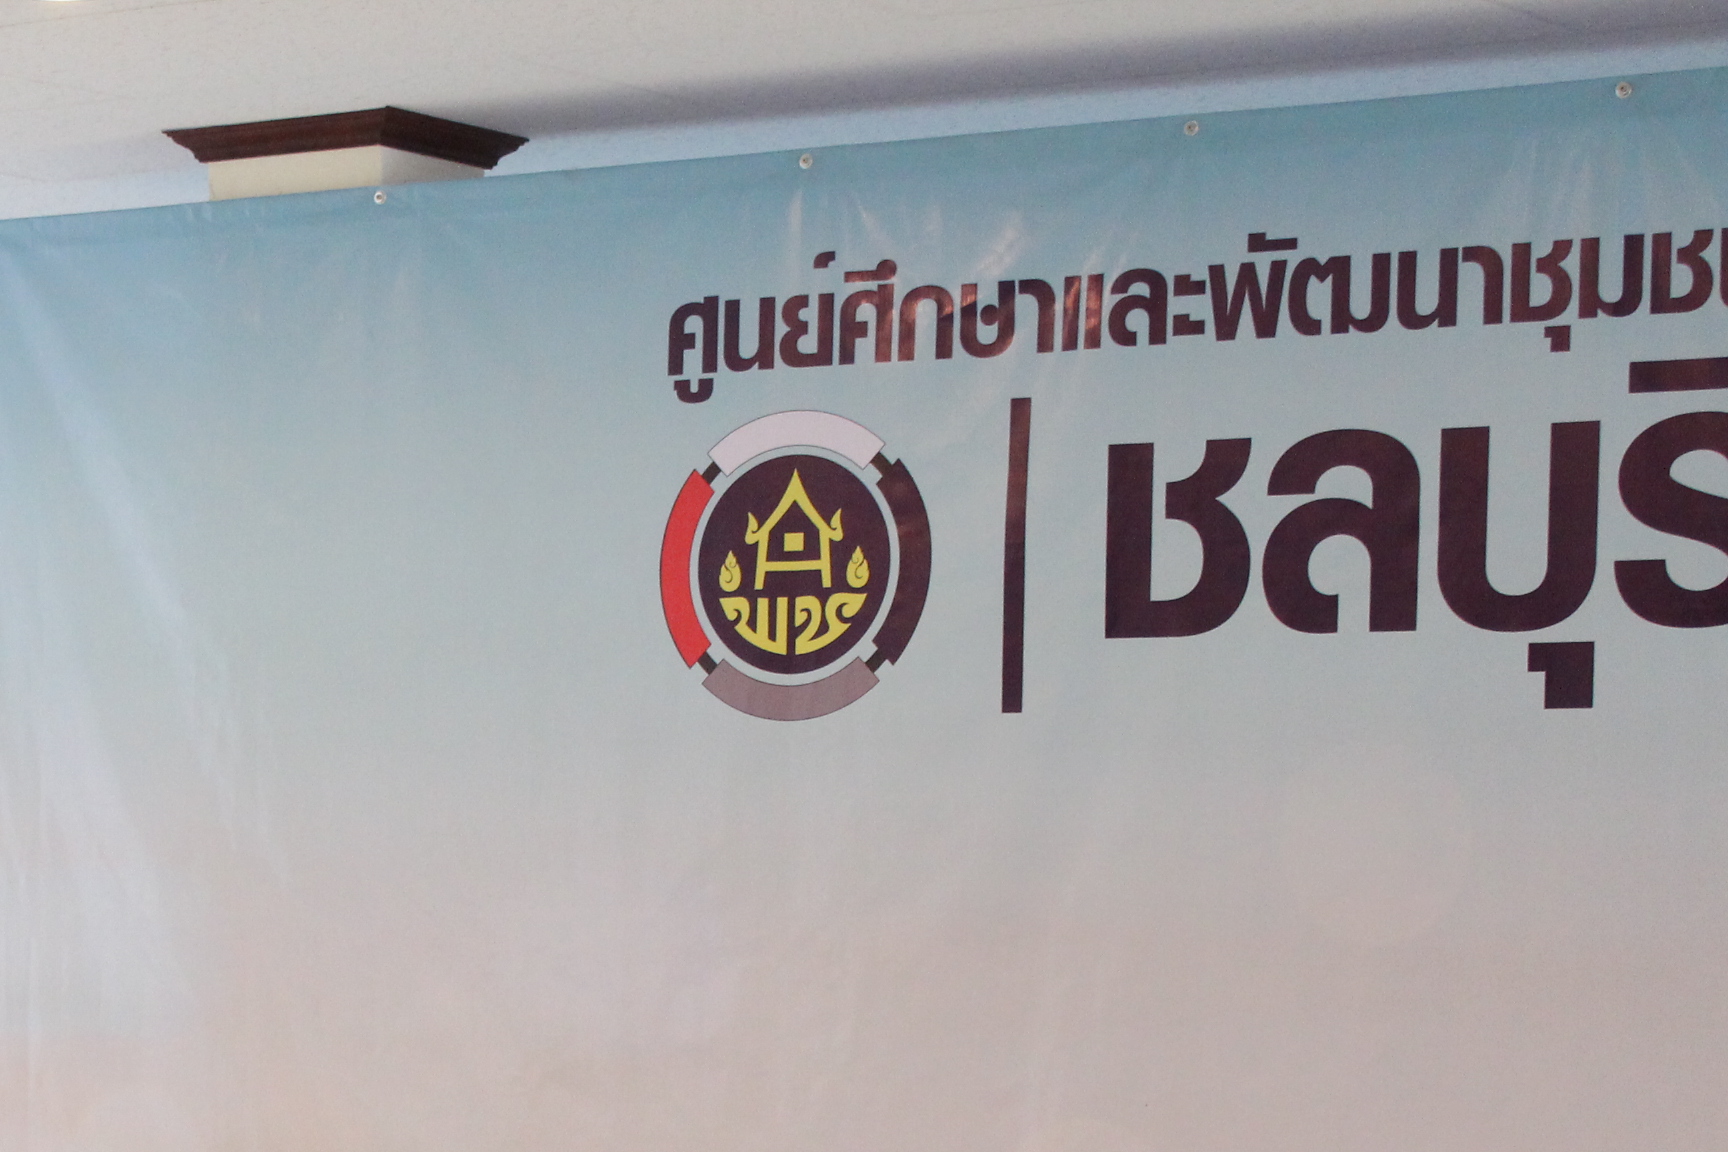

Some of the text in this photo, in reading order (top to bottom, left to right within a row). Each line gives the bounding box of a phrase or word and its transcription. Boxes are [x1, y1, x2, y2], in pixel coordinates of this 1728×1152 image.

[667, 226, 1728, 404] ศูนย์ศึกษาและพัฒนาชุมช
